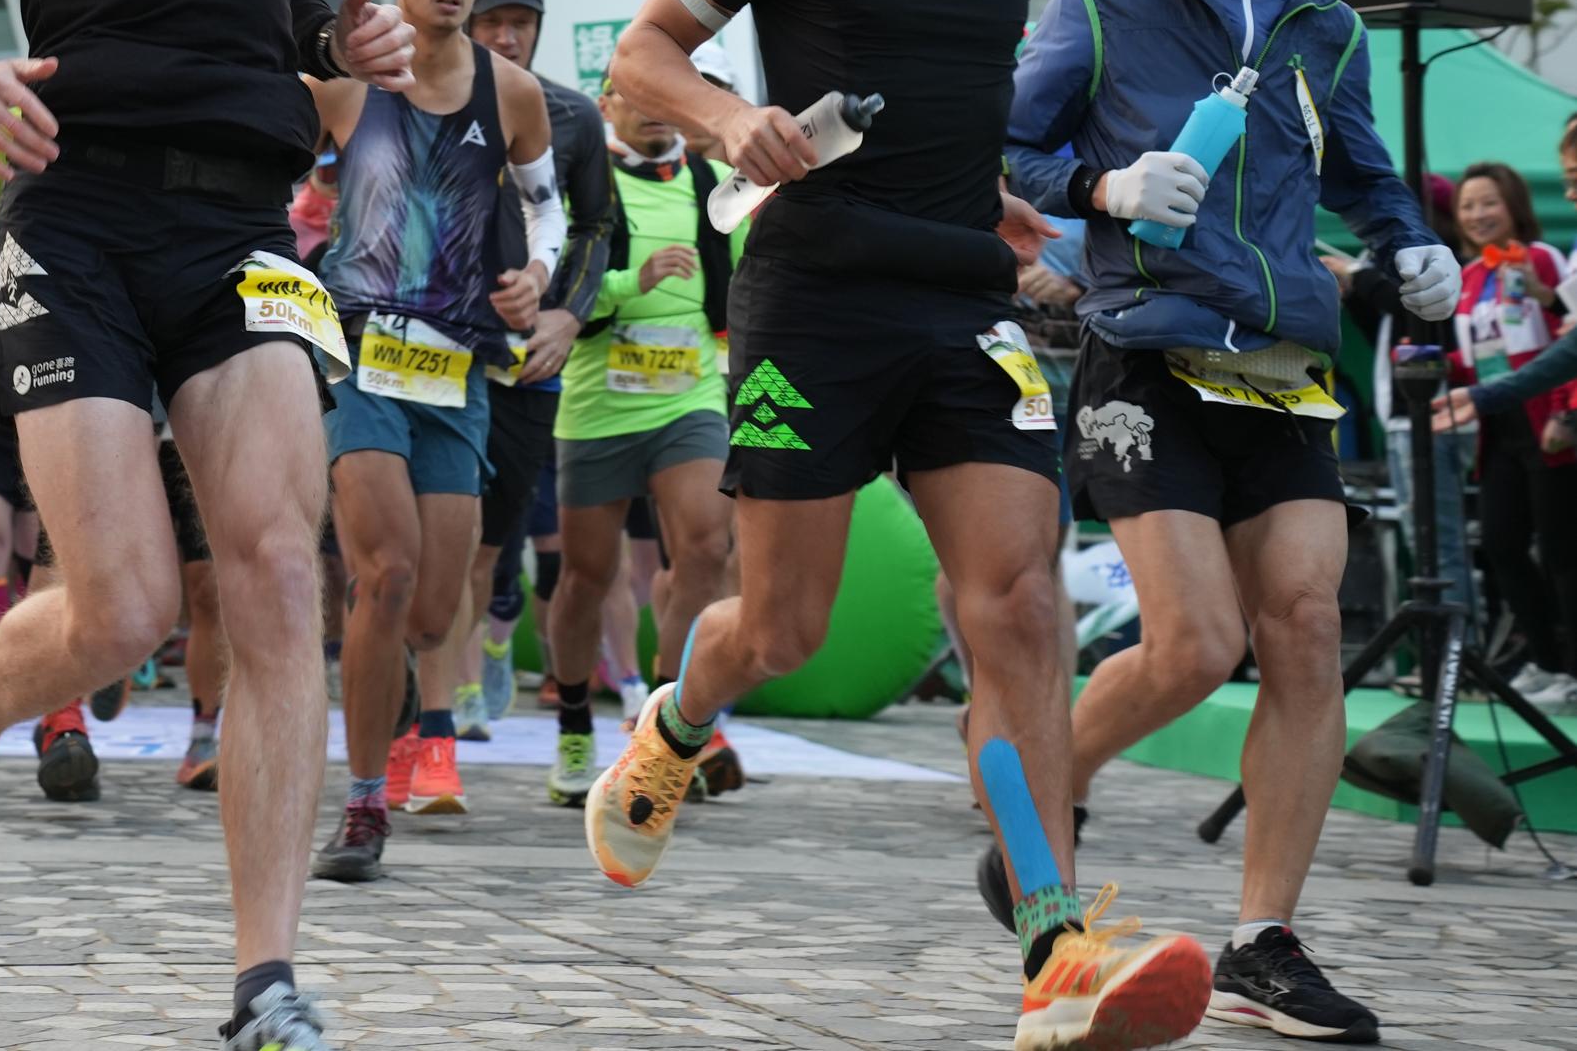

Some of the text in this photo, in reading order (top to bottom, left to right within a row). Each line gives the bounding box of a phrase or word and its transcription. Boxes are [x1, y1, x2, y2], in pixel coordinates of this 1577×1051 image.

[259, 300, 313, 334] 50km
[31, 360, 56, 378] gone
[372, 343, 452, 377] WM 7251
[647, 349, 686, 370] 7227
[32, 369, 76, 389] running
[365, 370, 406, 389] 50km
[1024, 397, 1049, 417] 50
